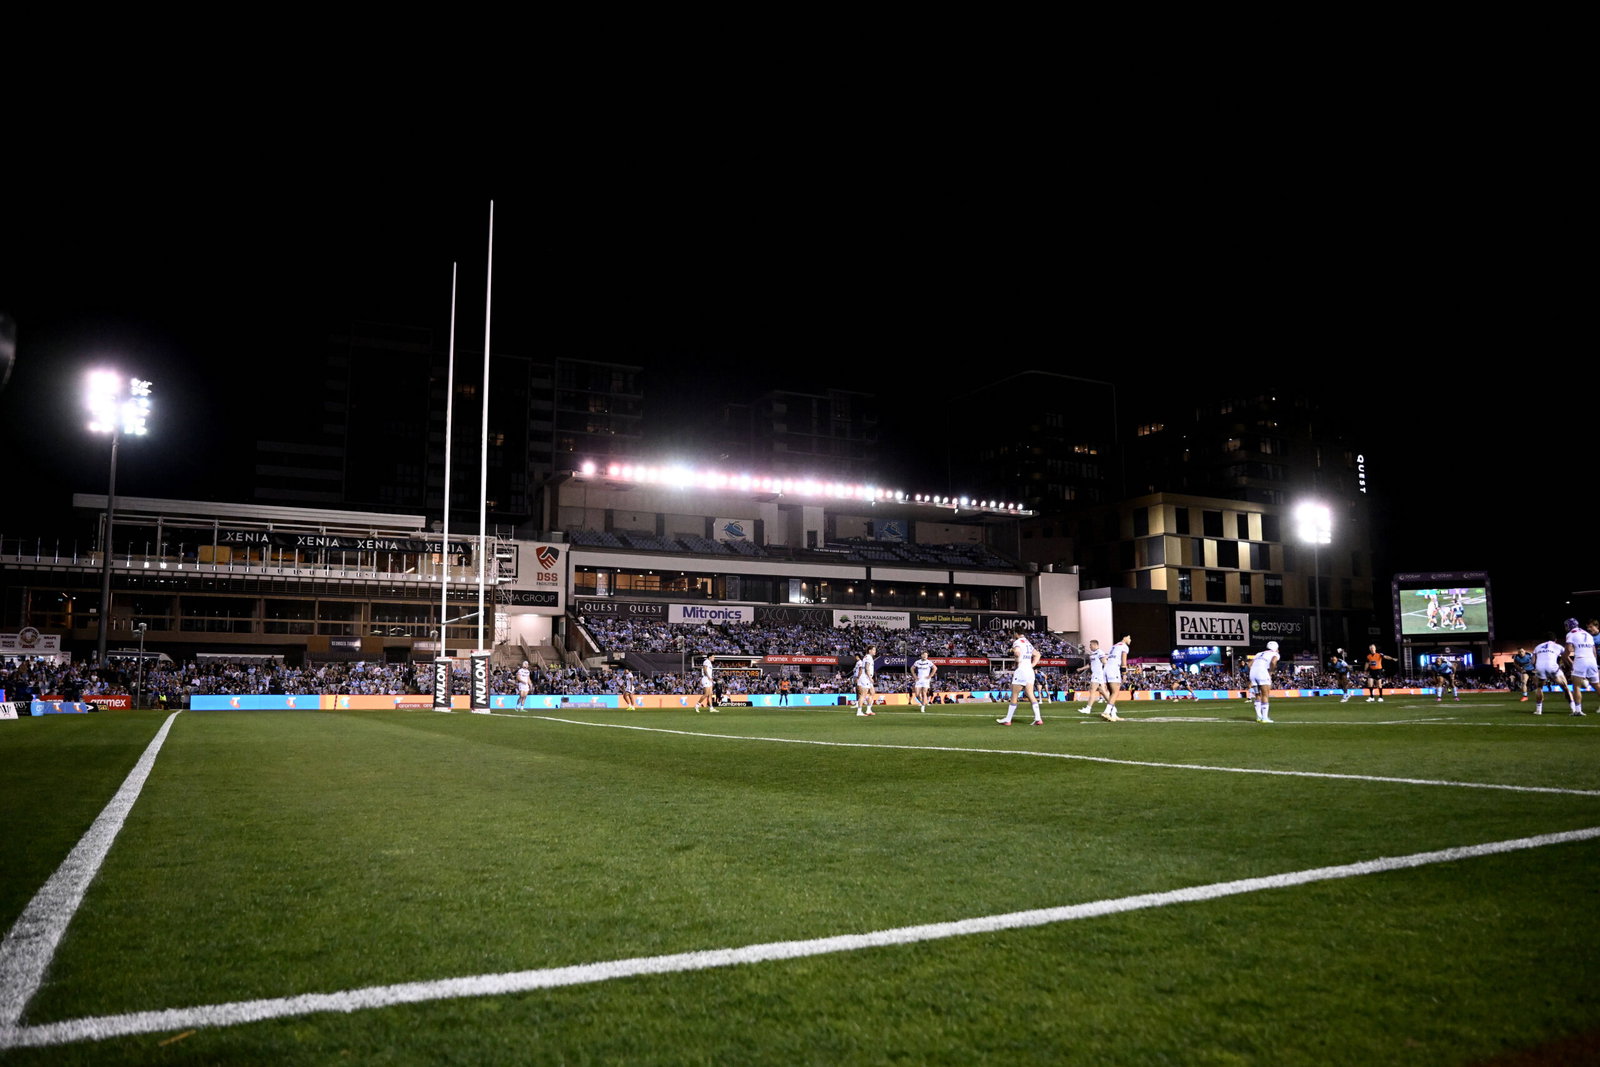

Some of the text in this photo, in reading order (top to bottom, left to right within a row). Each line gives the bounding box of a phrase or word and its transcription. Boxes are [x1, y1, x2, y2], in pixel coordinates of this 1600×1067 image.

[1357, 454, 1366, 494] QUEST
[226, 532, 464, 553] XENIA XENIA XENIA XEIA
[536, 572, 558, 582] DSS
[522, 594, 556, 603] GROUP
[584, 603, 662, 614] QUEST QUEST
[682, 606, 742, 619] Mitronics
[1002, 620, 1035, 630] HICON
[1180, 616, 1244, 633] PANETTA
[1261, 621, 1301, 633] easysigns
[436, 664, 446, 704] NULON
[476, 659, 486, 705] NULON
[90, 699, 126, 707] aramex
